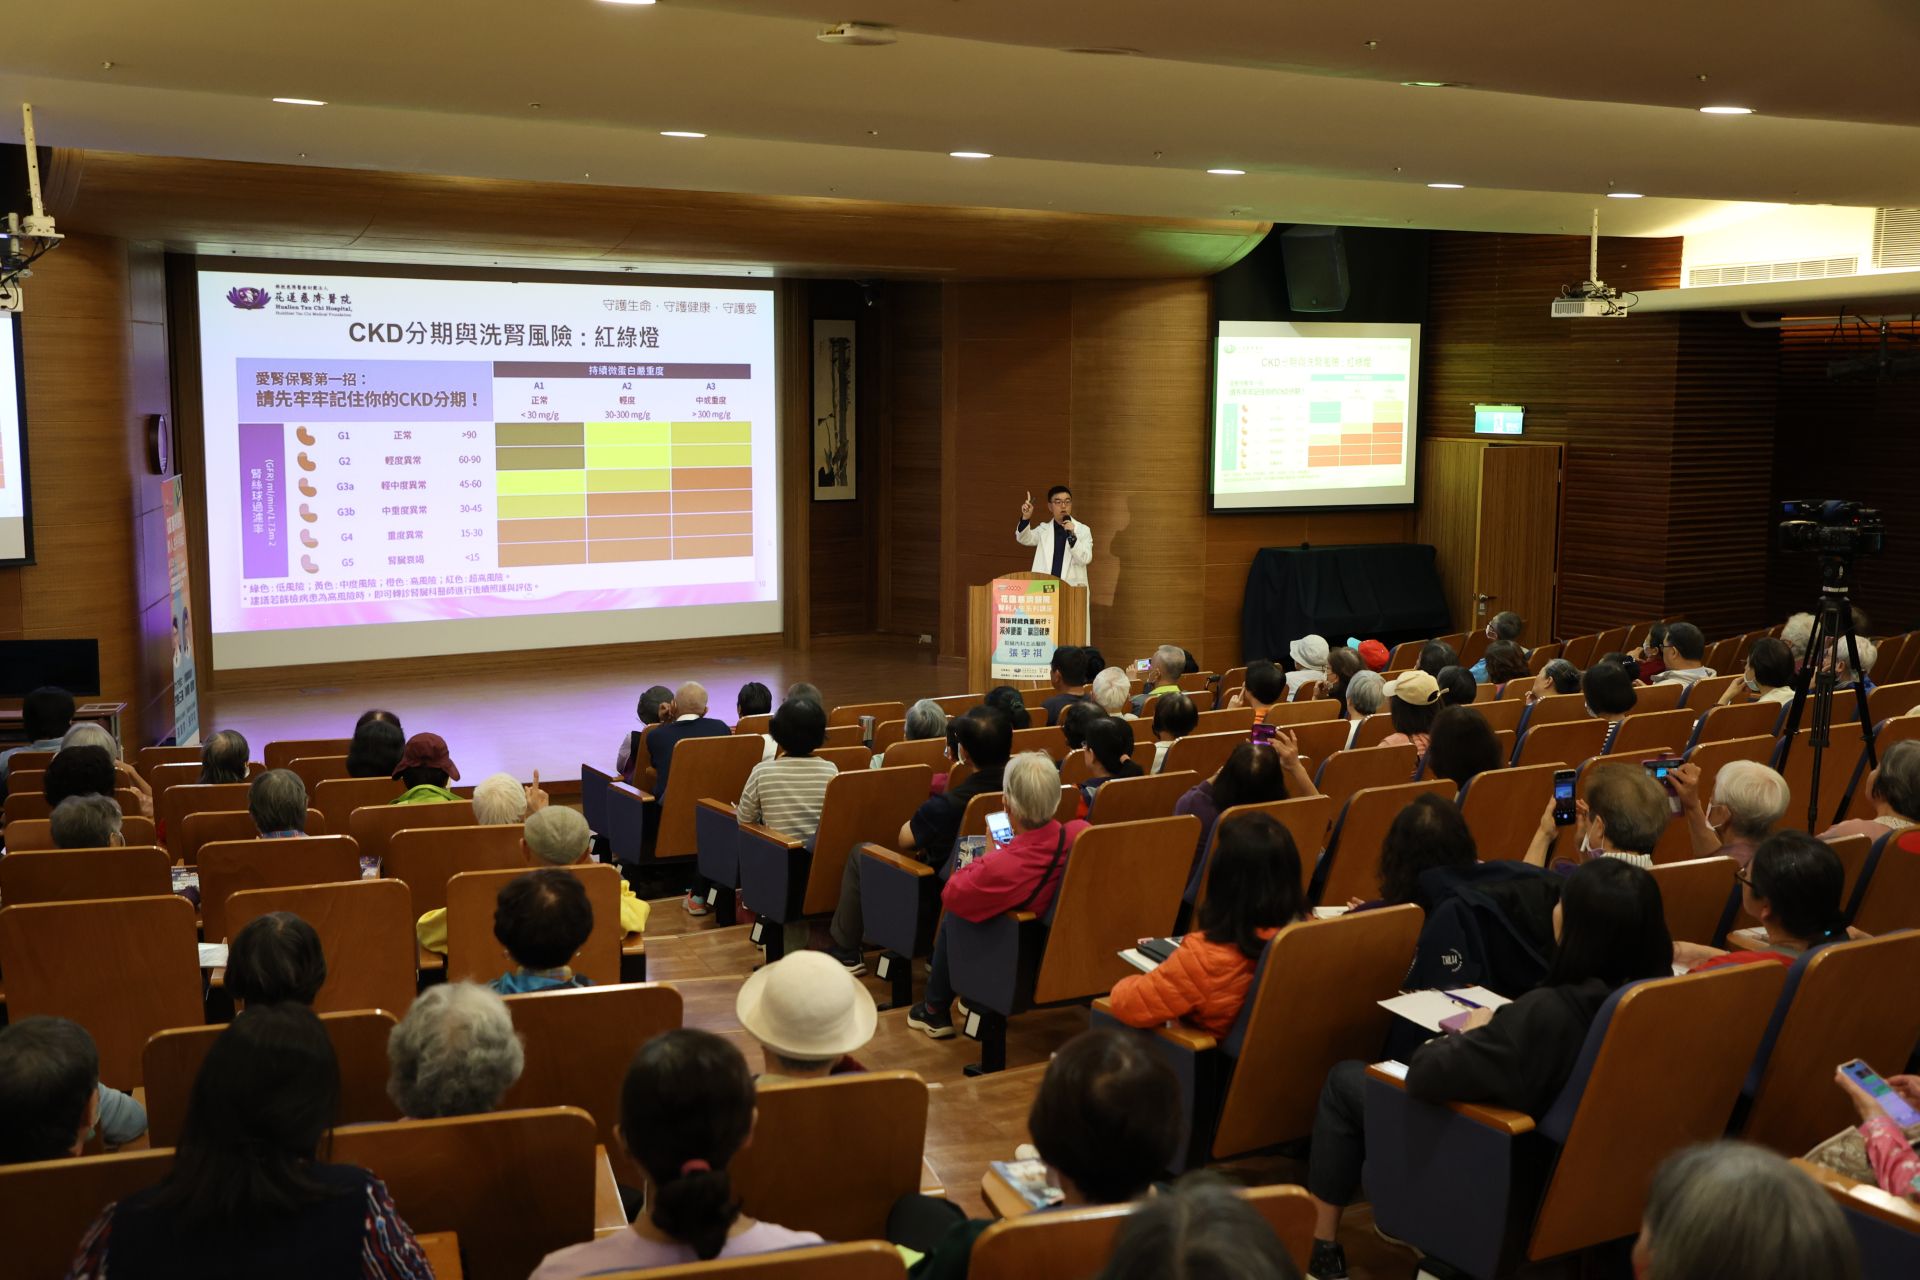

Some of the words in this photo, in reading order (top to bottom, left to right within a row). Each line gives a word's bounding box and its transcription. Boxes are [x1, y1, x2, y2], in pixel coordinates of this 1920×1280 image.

[275, 292, 352, 304] 花蓮慈濟醫院
[588, 365, 664, 376] 持續微蛋白嚴重度
[256, 371, 367, 386] 愛腎保腎第一招：
[534, 382, 544, 390] A1
[622, 382, 632, 390] A2
[706, 382, 716, 390] A3
[256, 390, 478, 408] 請先牢牢記住你的CKD分期！
[531, 395, 548, 405] 正常
[619, 396, 635, 405] 輕度
[695, 396, 726, 405] 中或重度
[630, 411, 651, 421] mg/g
[338, 431, 350, 440] G1
[394, 430, 412, 440] 正常
[462, 430, 477, 439] >90
[338, 456, 351, 465] G2
[385, 456, 422, 466] 輕度異常
[458, 455, 481, 464] 60-90
[337, 482, 354, 491] G3a
[381, 480, 426, 491] 輕中度異常
[459, 480, 482, 488] 45-60
[337, 507, 355, 517] G3b
[382, 505, 428, 516] 中重度異常
[460, 504, 482, 513] 30-45
[387, 530, 424, 541] 重度異常
[461, 528, 483, 537] 15-30
[341, 533, 353, 542] G4
[387, 555, 424, 566] 腎臟衰竭
[465, 553, 480, 562] <15
[341, 558, 354, 567] G5
